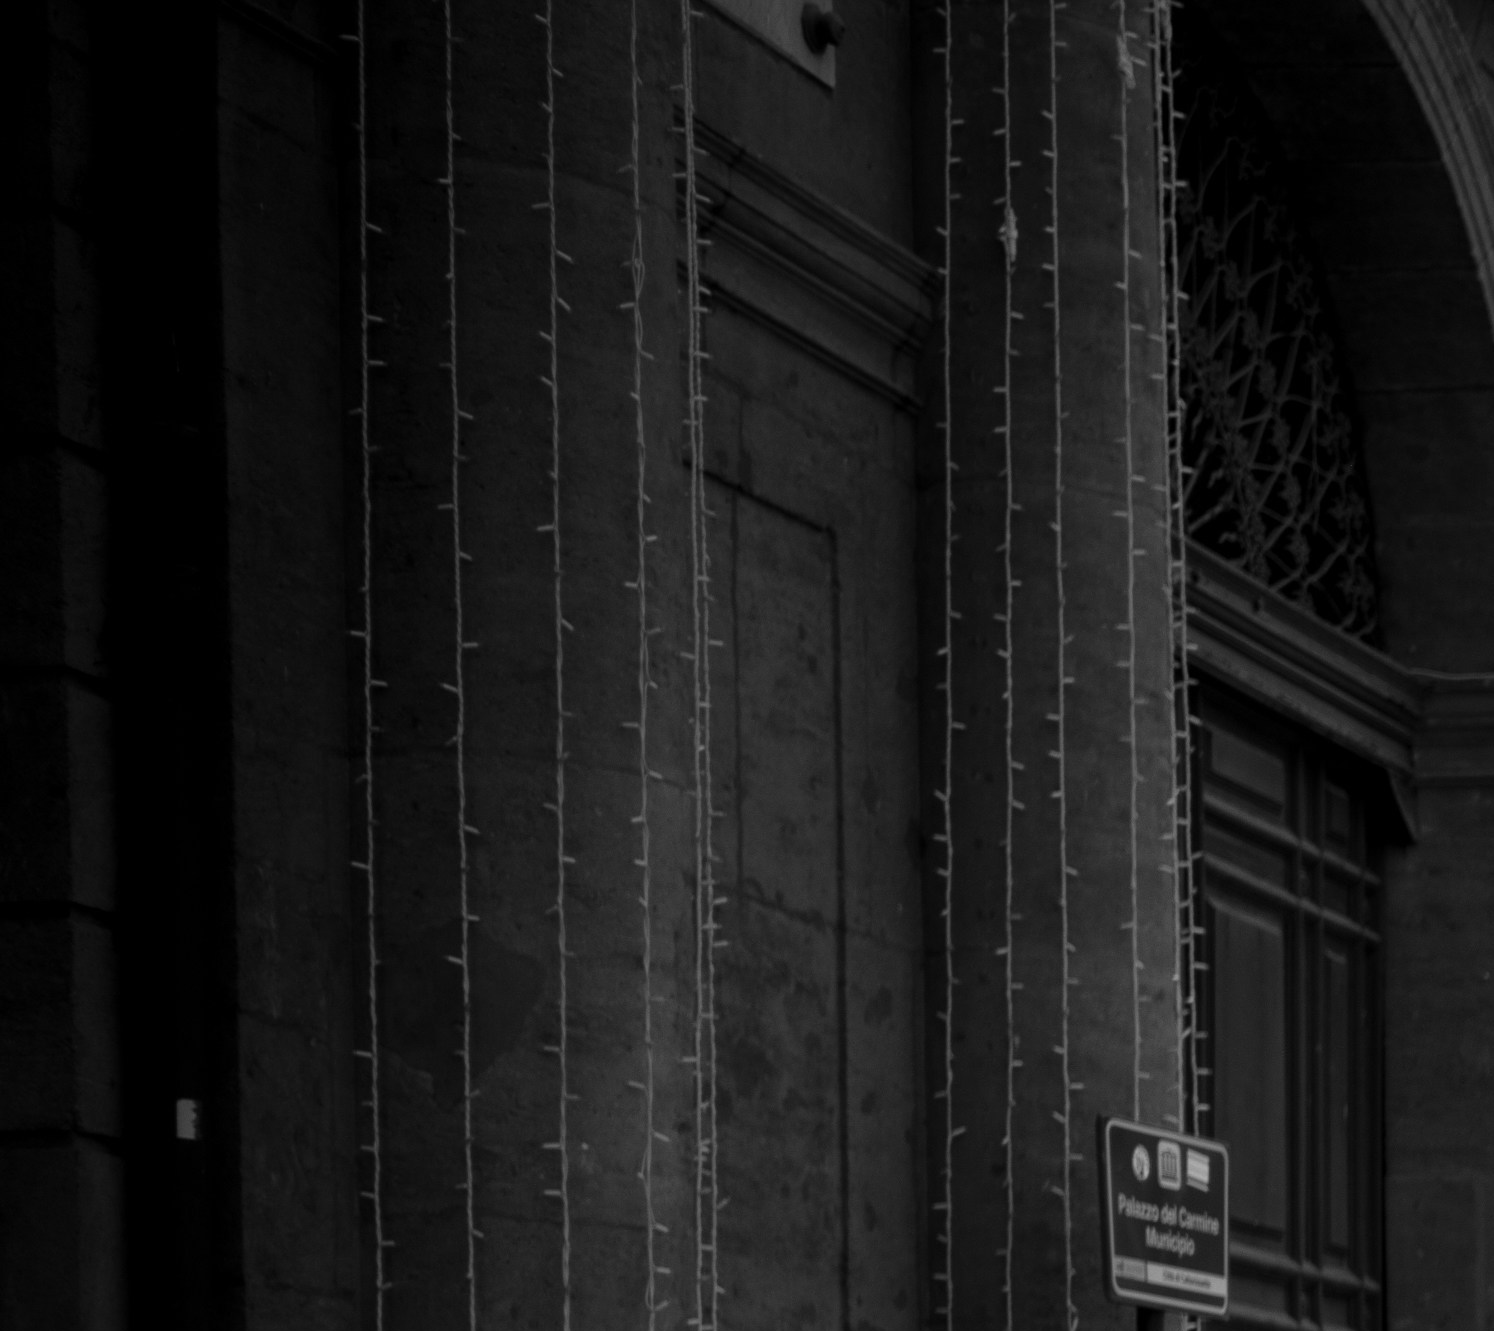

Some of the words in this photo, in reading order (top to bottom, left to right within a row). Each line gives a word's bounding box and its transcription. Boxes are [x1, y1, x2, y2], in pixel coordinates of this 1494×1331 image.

[1117, 1192, 1159, 1221] Palazzo
[1161, 1201, 1177, 1226] del
[1179, 1205, 1220, 1236] Carmine
[1145, 1223, 1195, 1257] Municipio
